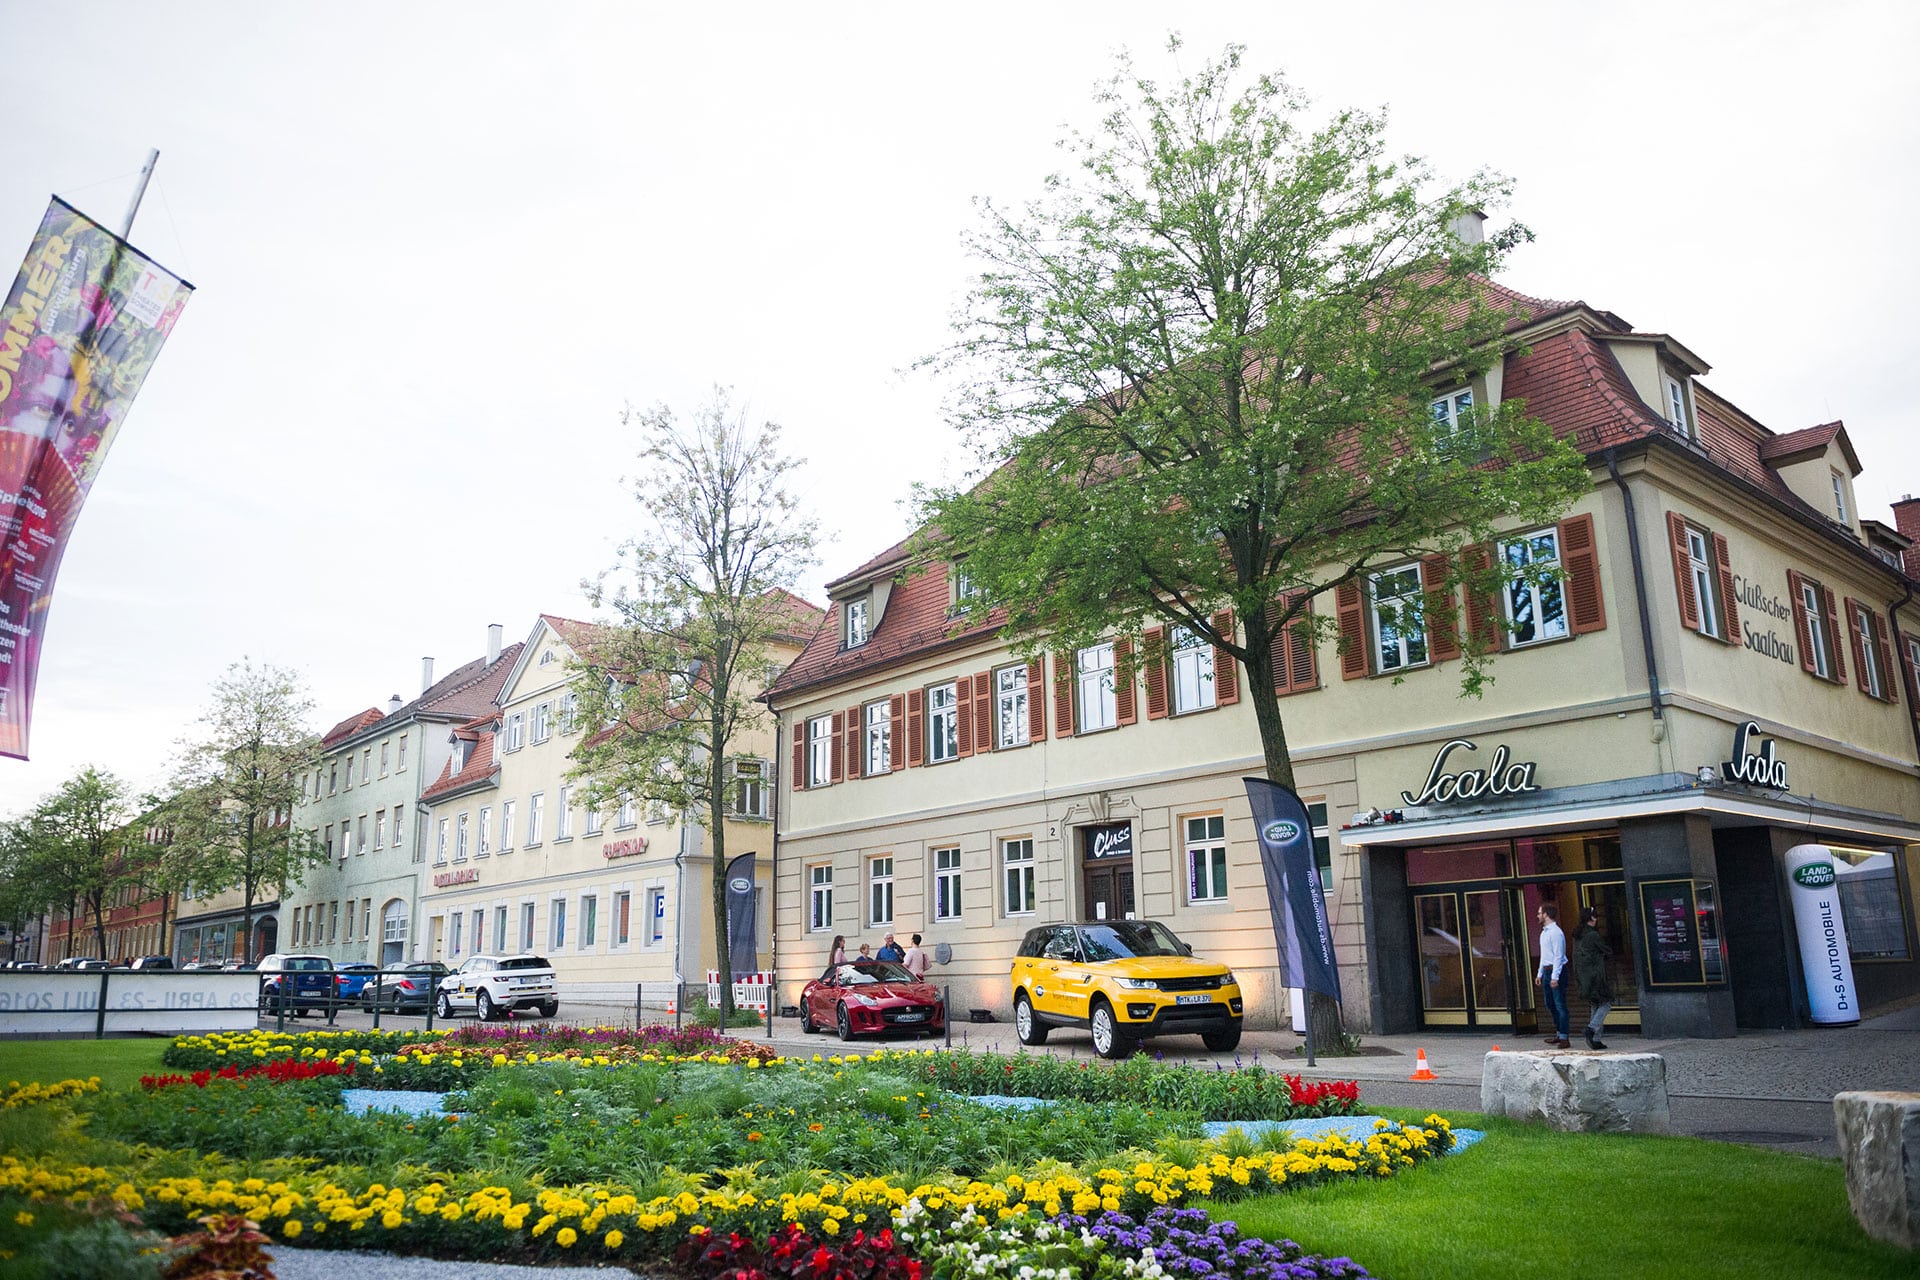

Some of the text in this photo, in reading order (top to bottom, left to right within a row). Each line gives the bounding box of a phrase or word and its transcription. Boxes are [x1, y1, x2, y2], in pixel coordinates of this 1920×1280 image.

[41, 248, 85, 334] Ludwigsburg
[1733, 574, 1791, 622] Clußscher
[1743, 620, 1795, 665] Saalbau
[1400, 738, 1542, 807] Scala
[1721, 720, 1790, 791] Scala
[1050, 826, 1057, 837] 2
[1801, 866, 1828, 877] LAND
[1805, 874, 1834, 884] ROVER
[657, 898, 664, 916] P
[1820, 901, 1843, 981] AUTOMOBILE
